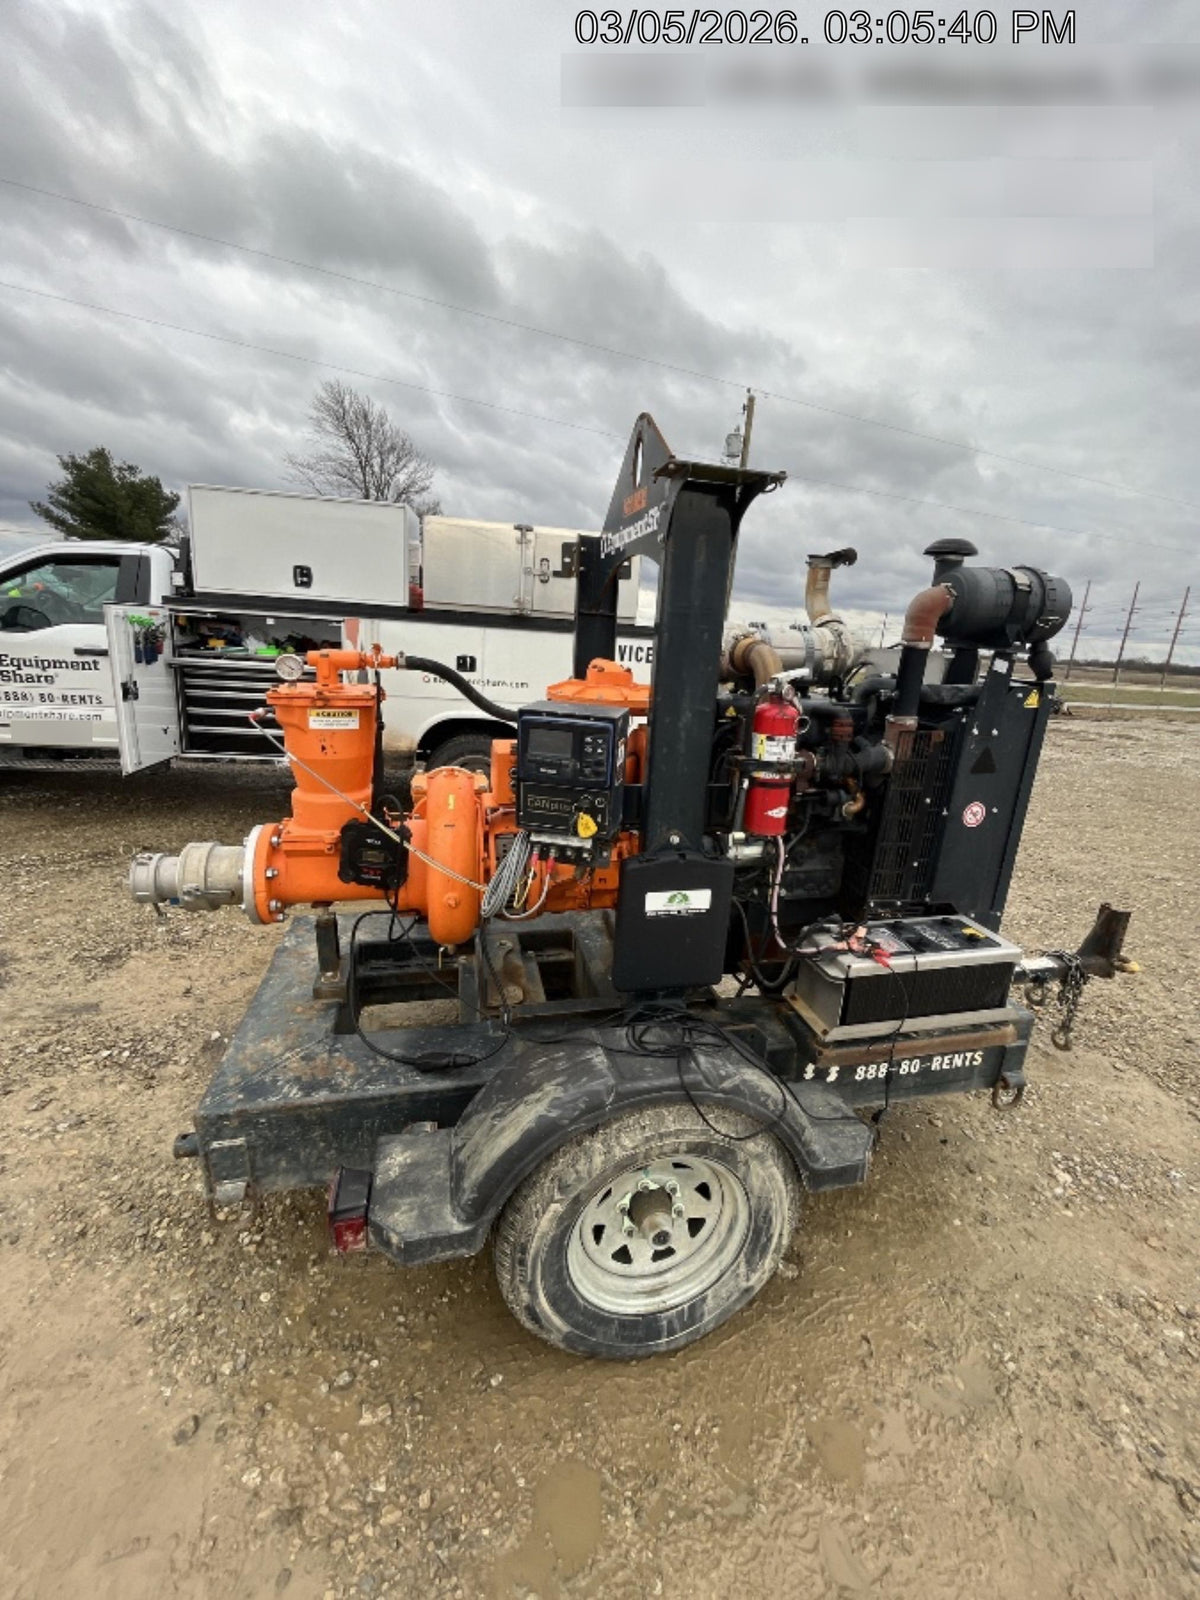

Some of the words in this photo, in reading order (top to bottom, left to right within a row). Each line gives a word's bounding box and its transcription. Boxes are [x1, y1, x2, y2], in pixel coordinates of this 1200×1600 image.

[0, 654, 100, 671] Equipment
[617, 645, 655, 664] VICE
[0, 670, 55, 684] Share
[855, 1051, 984, 1081] 888-80-RENTS
